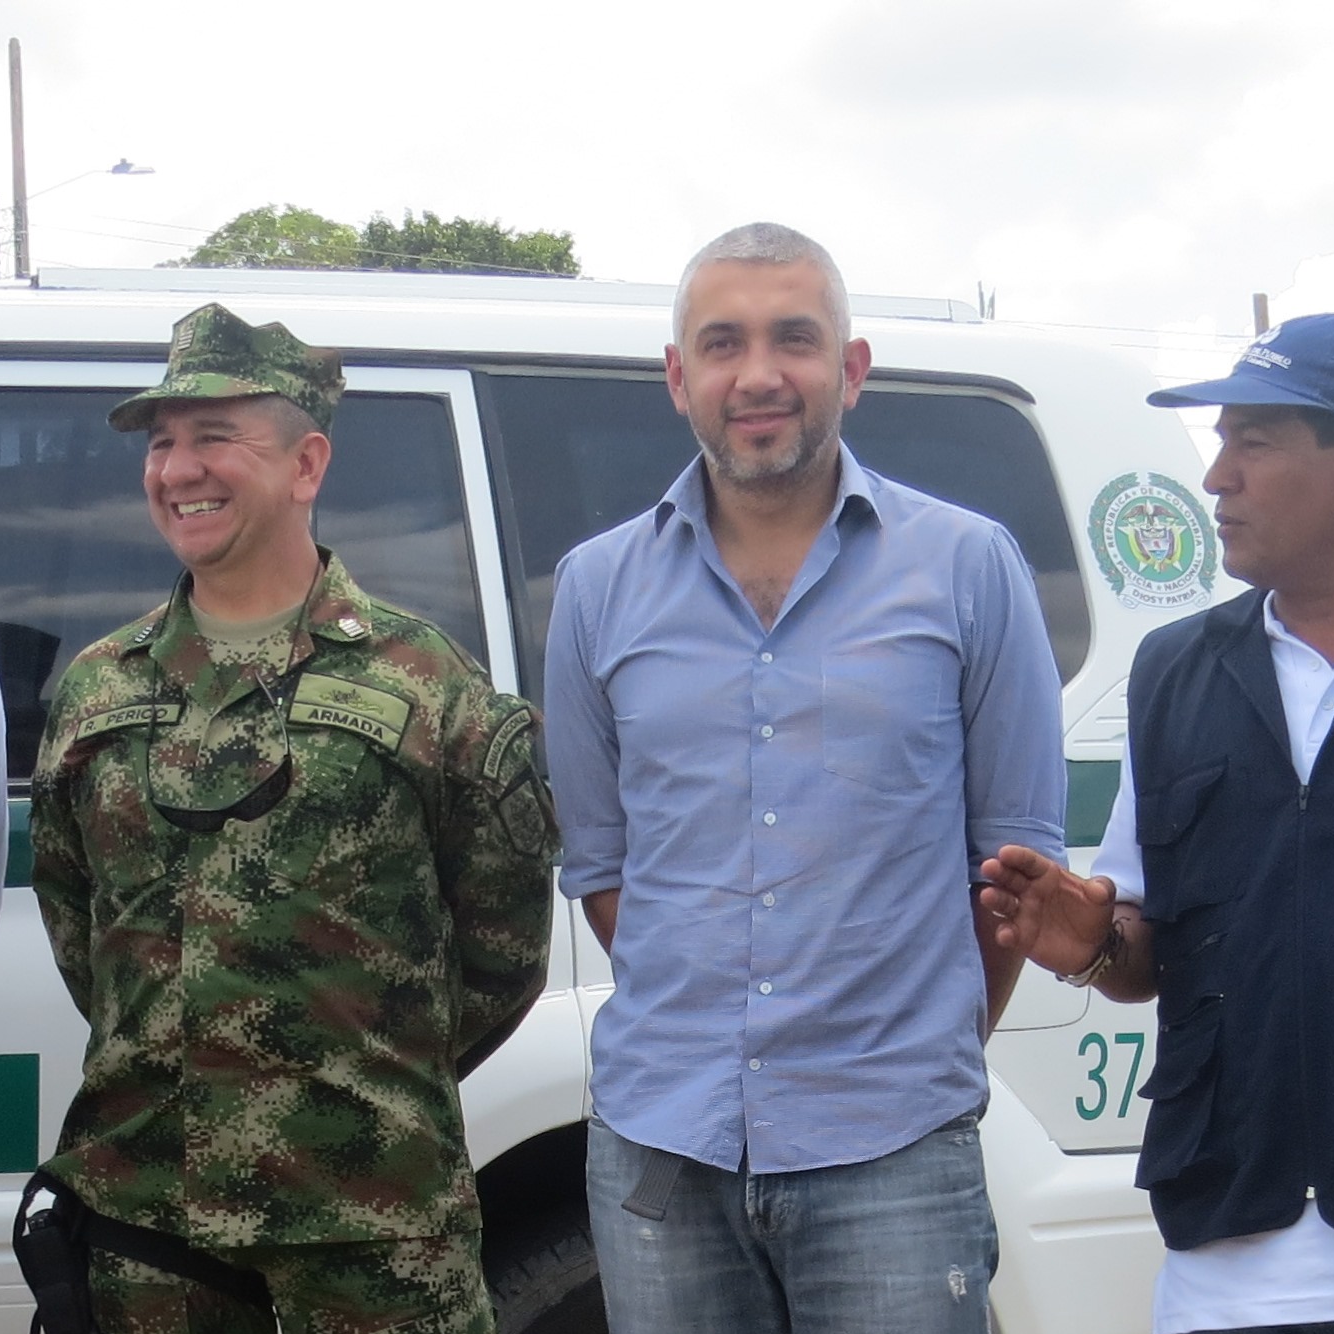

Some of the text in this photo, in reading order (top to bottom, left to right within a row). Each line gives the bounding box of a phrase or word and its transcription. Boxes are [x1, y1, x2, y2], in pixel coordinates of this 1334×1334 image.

[1140, 486, 1154, 496] DE
[1165, 493, 1203, 547] COLOMBIA
[1163, 559, 1203, 592] NACIONAL
[1166, 588, 1197, 604] PATRIA
[84, 721, 97, 733] R.
[308, 708, 384, 740] ARMADA
